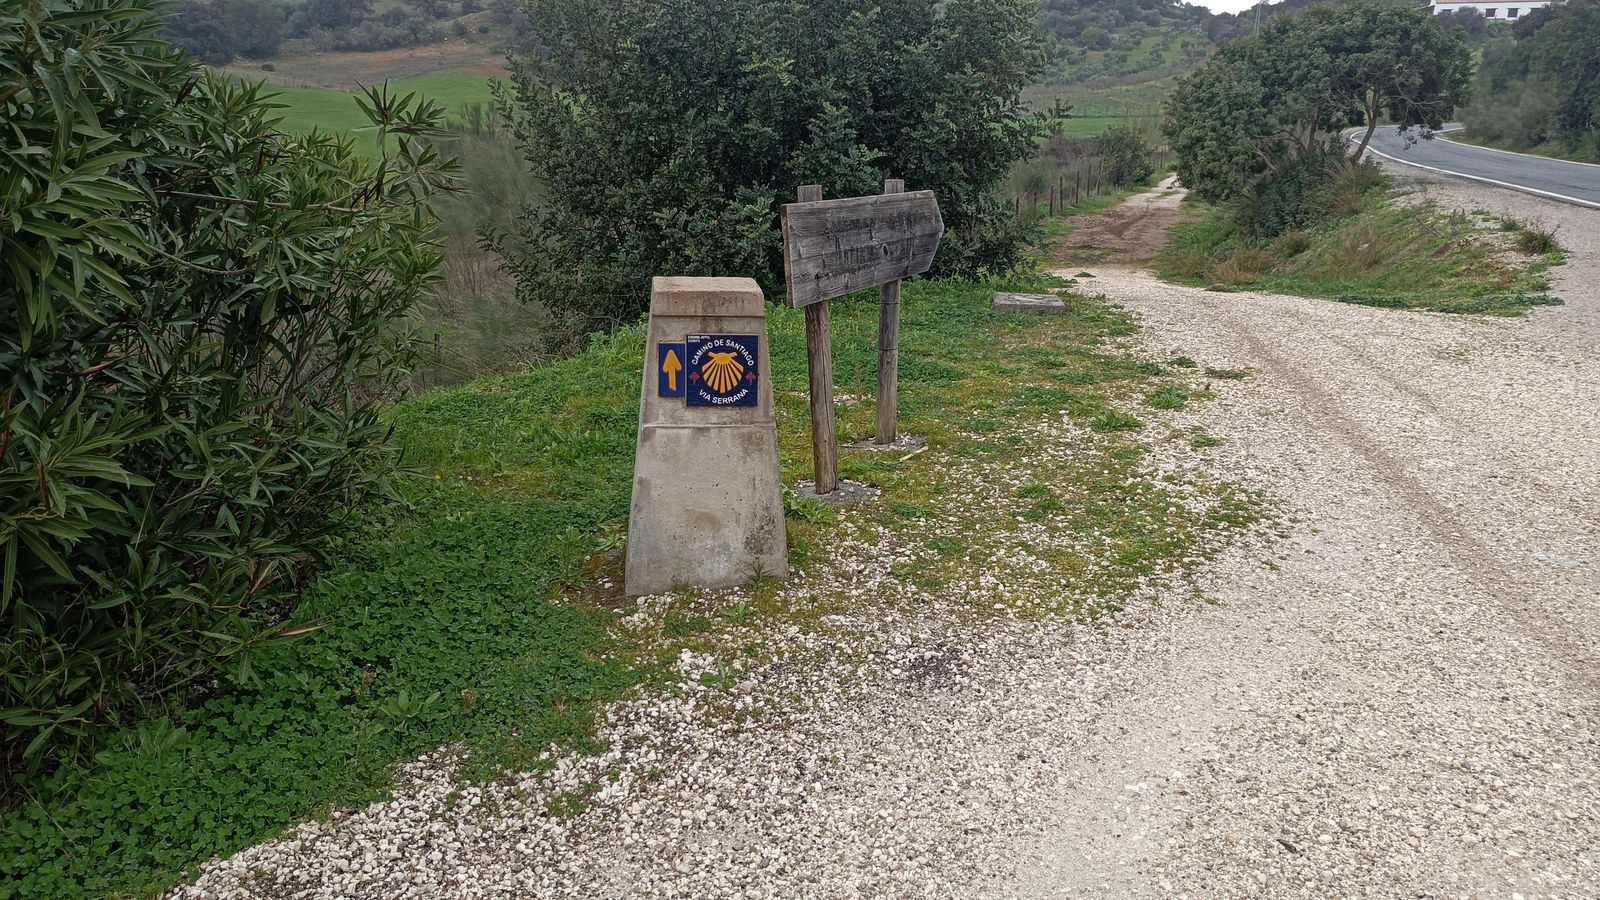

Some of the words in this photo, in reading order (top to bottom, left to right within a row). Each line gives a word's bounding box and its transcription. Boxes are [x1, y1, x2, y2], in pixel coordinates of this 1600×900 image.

[692, 342, 713, 365] CAMINO
[714, 339, 724, 347] DE
[725, 339, 754, 366] SANTIAGO
[699, 389, 711, 401] VIA
[712, 388, 749, 404] SERRANA
